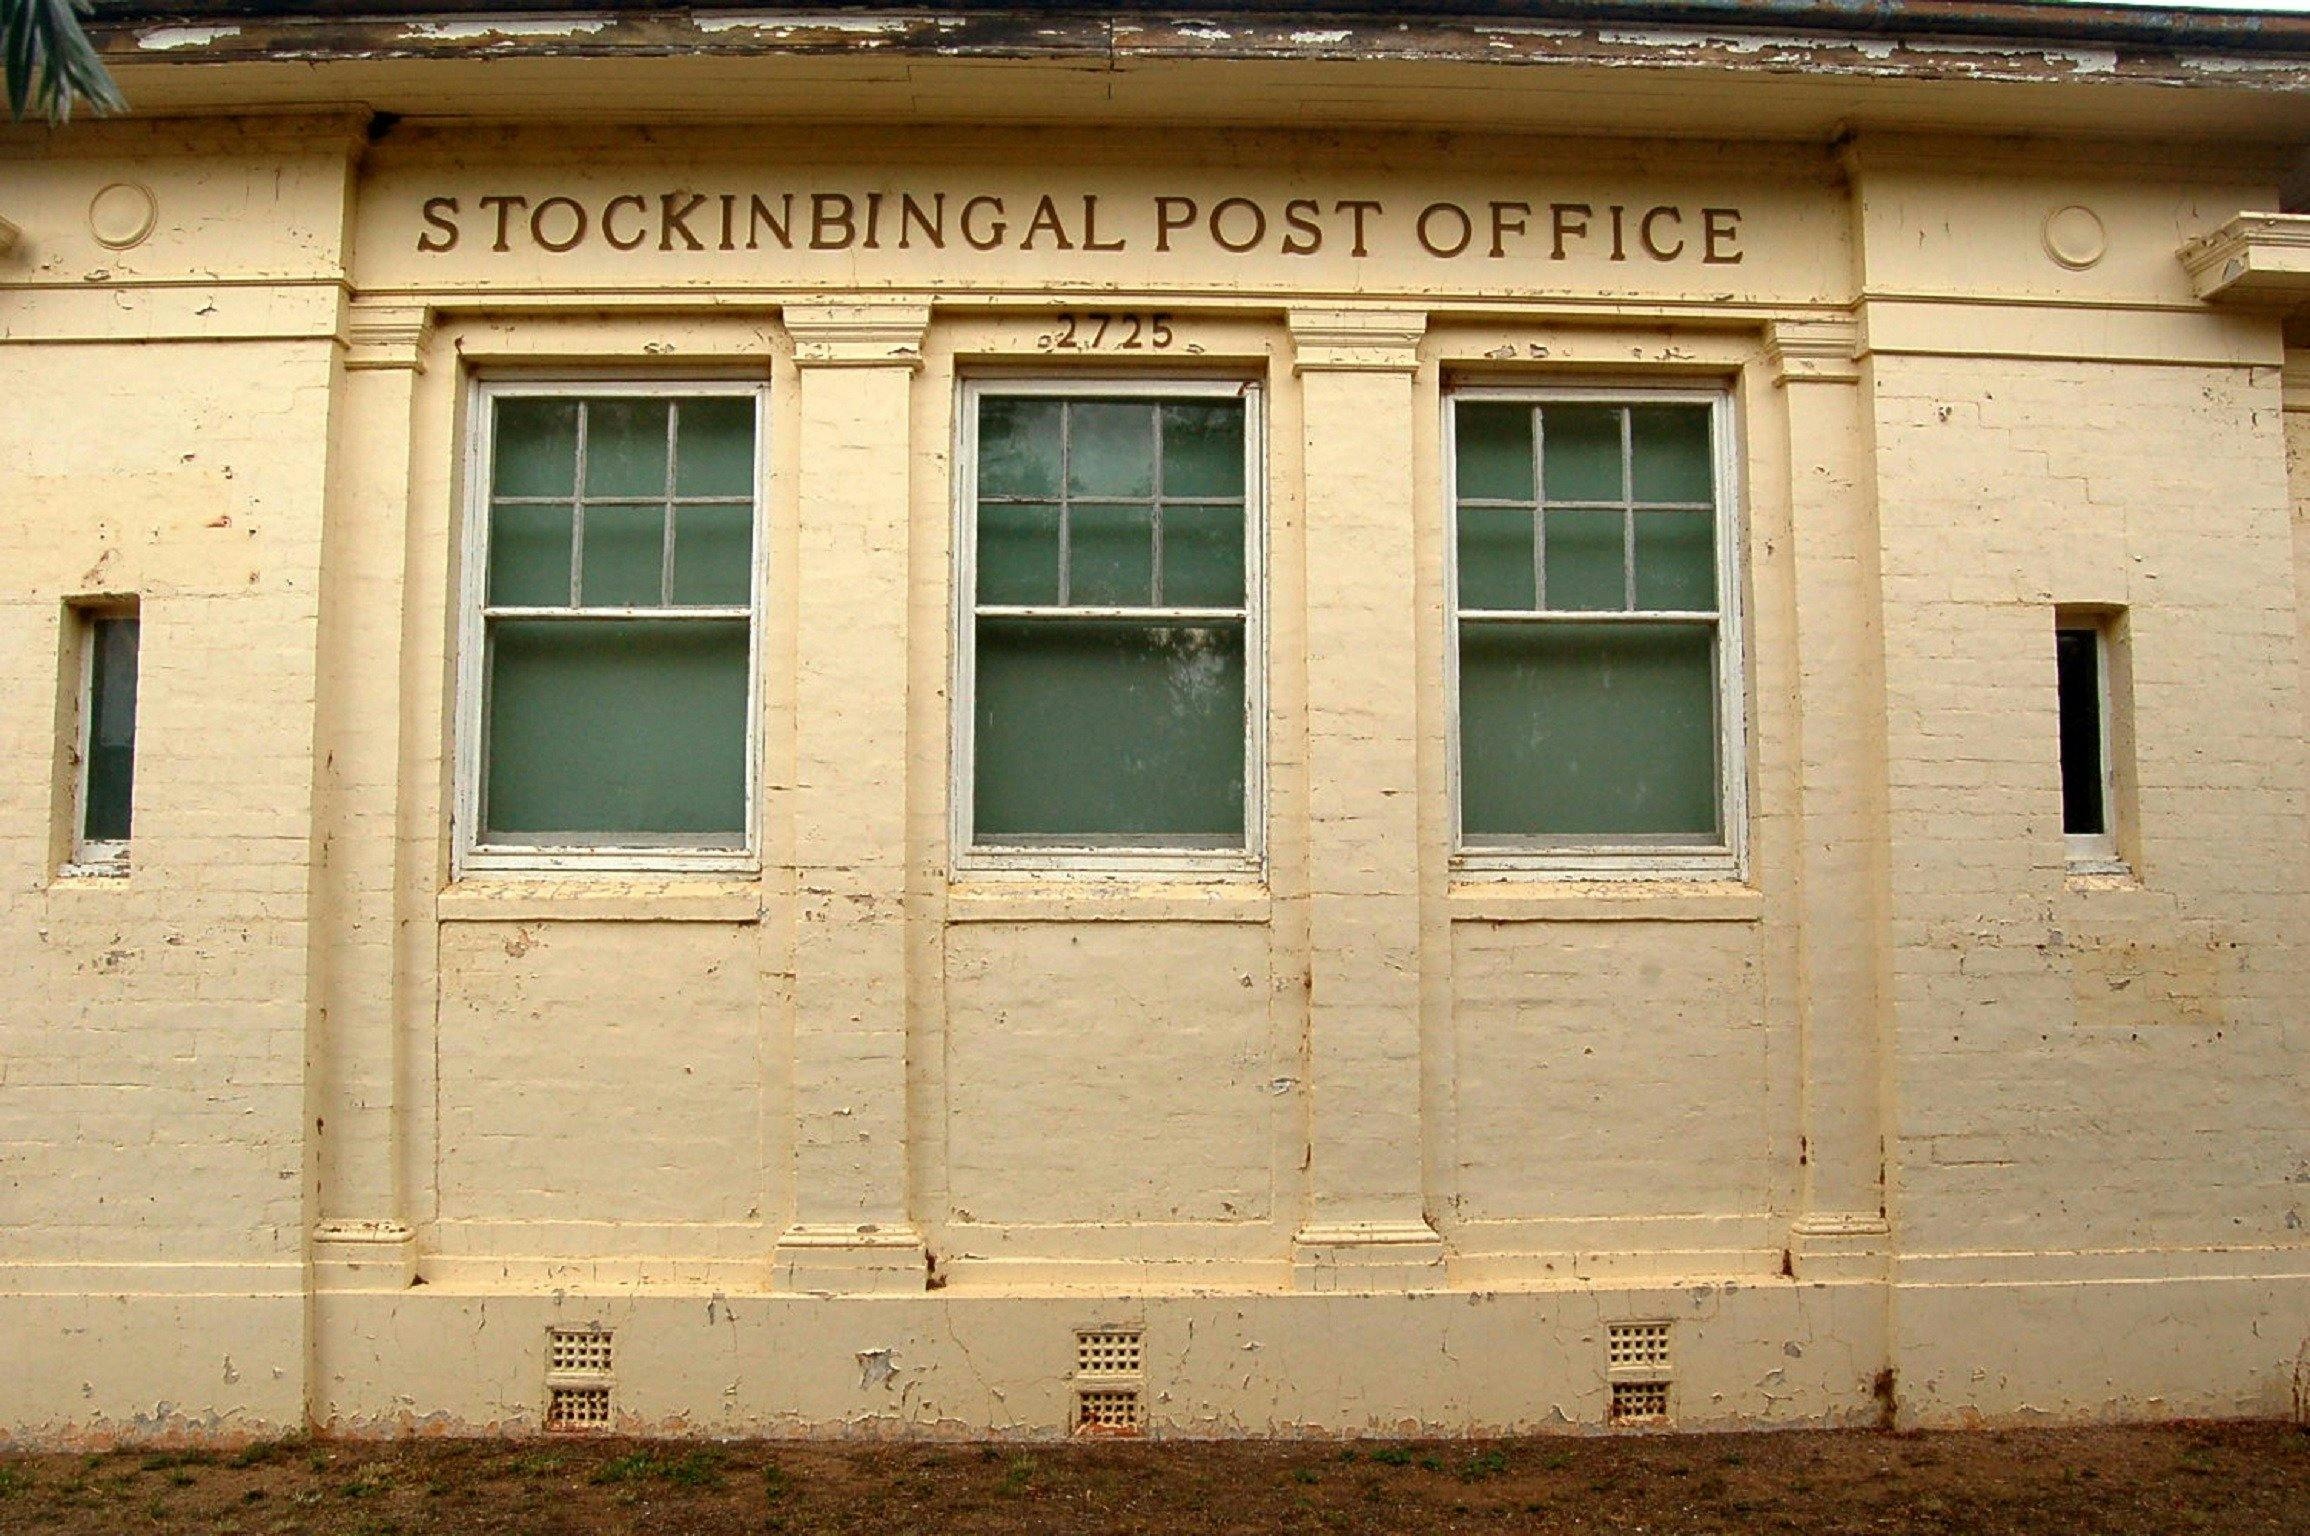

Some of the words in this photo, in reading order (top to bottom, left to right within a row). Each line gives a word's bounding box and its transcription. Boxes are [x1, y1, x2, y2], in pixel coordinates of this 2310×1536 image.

[417, 192, 1126, 252] STOCKINBINGAL
[1154, 196, 1383, 257] POST
[1416, 201, 1744, 264] OFFICE
[1057, 312, 1173, 348] 2725
